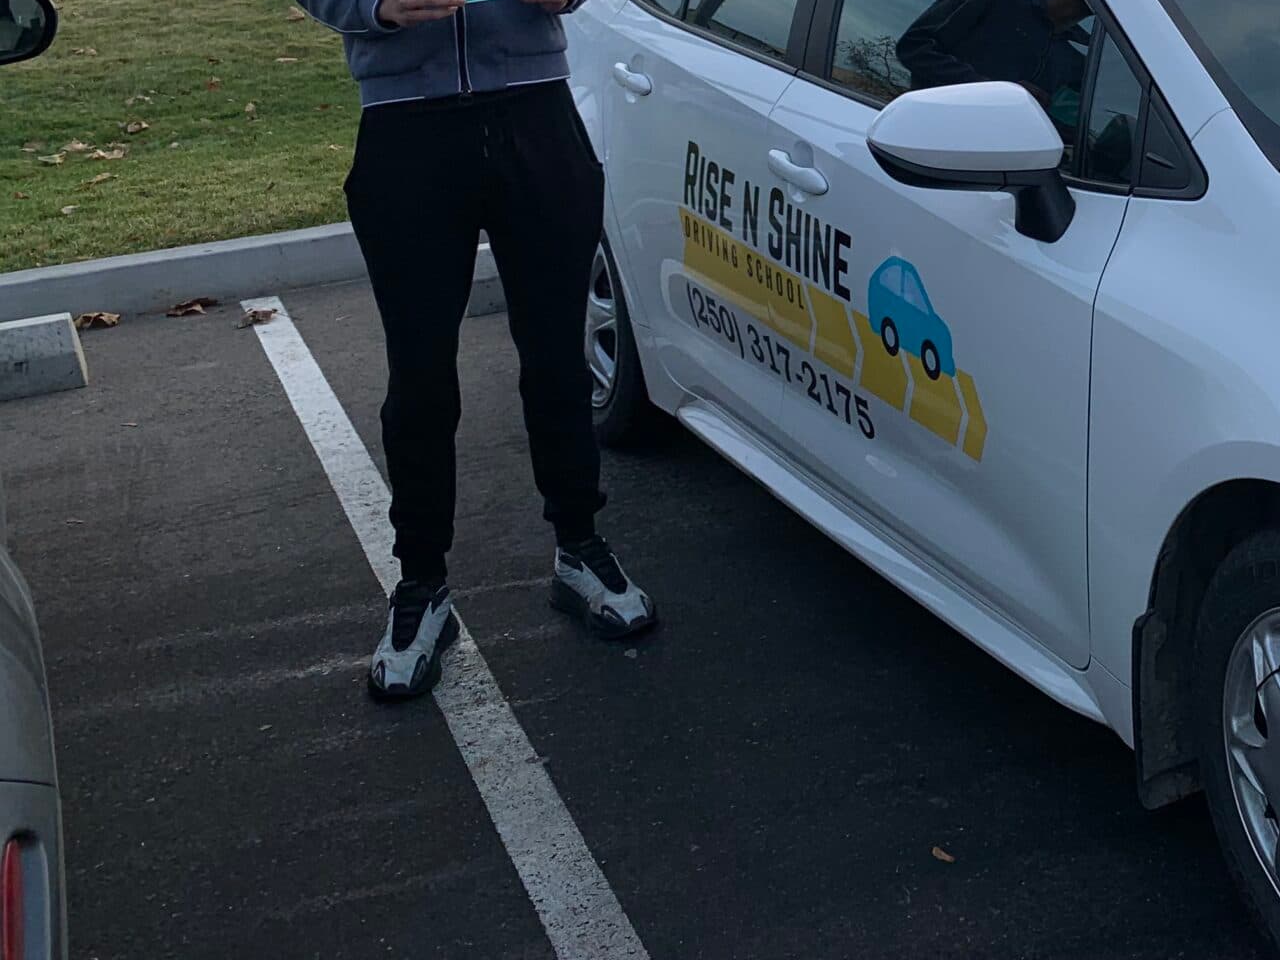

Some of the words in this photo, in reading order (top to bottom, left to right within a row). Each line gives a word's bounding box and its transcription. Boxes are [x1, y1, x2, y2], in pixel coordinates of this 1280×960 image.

[684, 140, 735, 232] RISE
[742, 180, 760, 248] N
[768, 187, 852, 302] SHINE
[684, 215, 738, 269] DRIVING
[746, 253, 805, 310] SCHOOL
[686, 281, 745, 359] (250)
[748, 324, 875, 440] 317-2175
